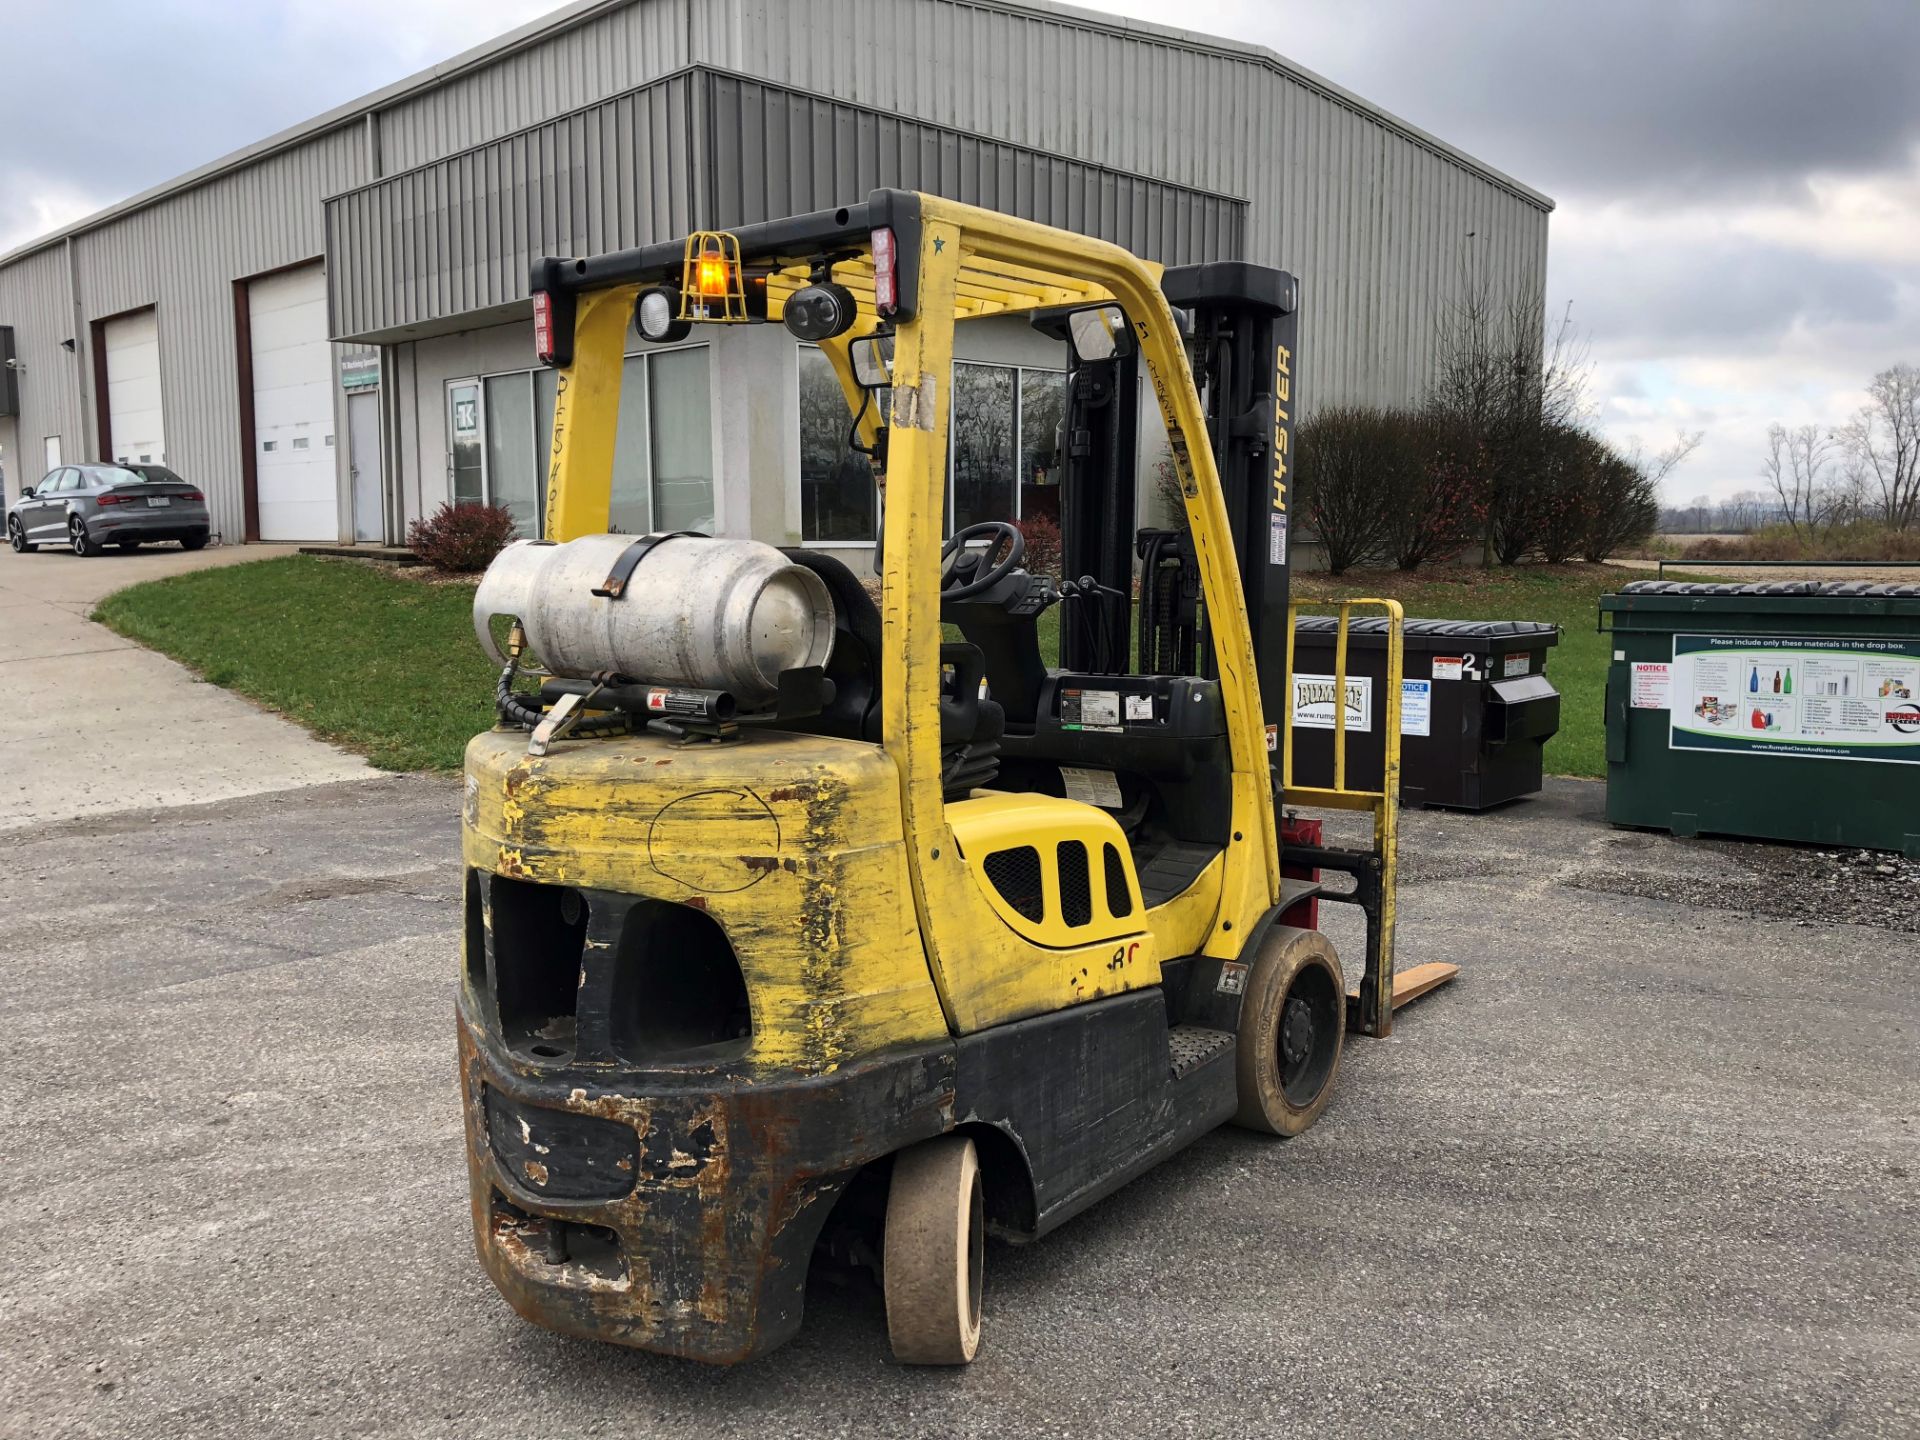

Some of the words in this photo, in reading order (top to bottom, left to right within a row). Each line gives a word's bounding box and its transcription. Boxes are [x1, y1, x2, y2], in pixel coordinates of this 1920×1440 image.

[1273, 345, 1291, 511] HYSTER
[1867, 642, 1886, 650] drop
[1463, 652, 1476, 672] 2
[1636, 664, 1668, 672] NOTICE
[1401, 683, 1425, 692] OTICE
[1297, 712, 1362, 722] www.rump.com
